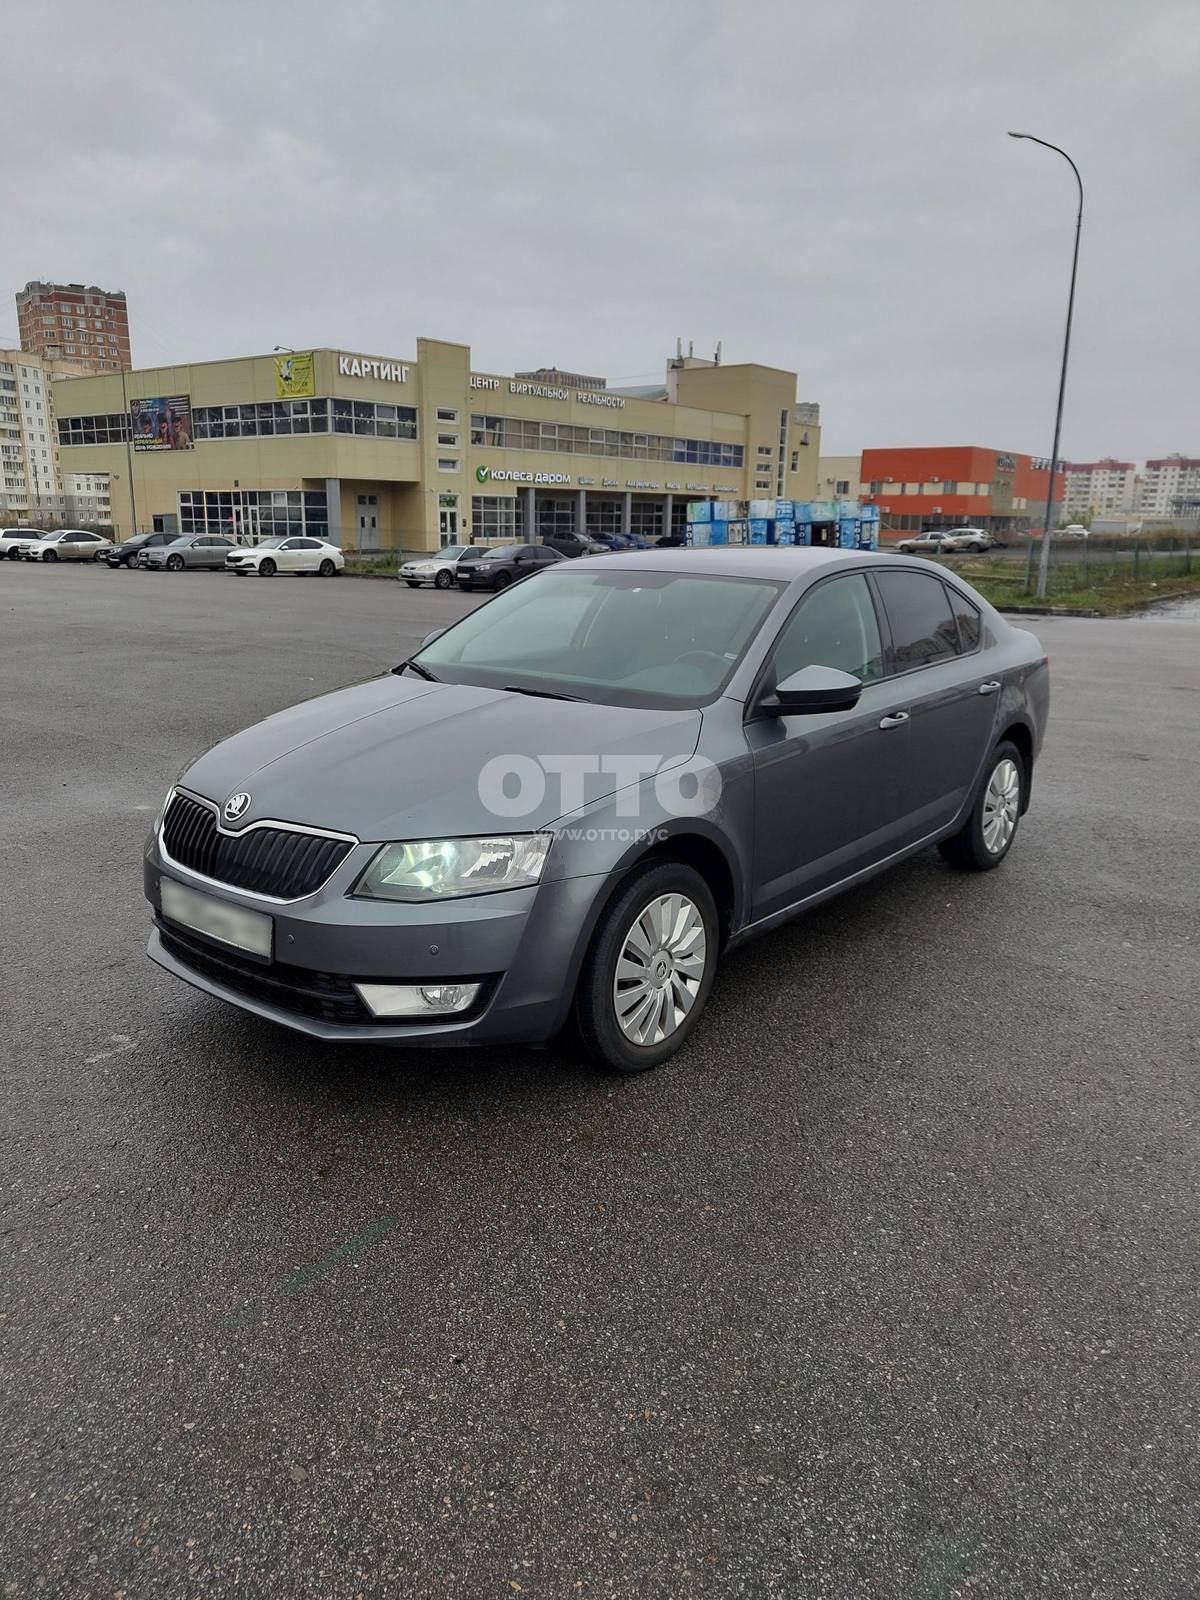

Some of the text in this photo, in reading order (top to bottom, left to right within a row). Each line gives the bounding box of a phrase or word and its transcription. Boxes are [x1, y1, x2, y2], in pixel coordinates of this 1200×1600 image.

[339, 356, 409, 383] КАРТИНГ
[470, 376, 625, 408] ЦЕНТР ВИРТУАЛЬНОЙ РЕАЛЬНОСТИ
[490, 470, 571, 484] колеса даром
